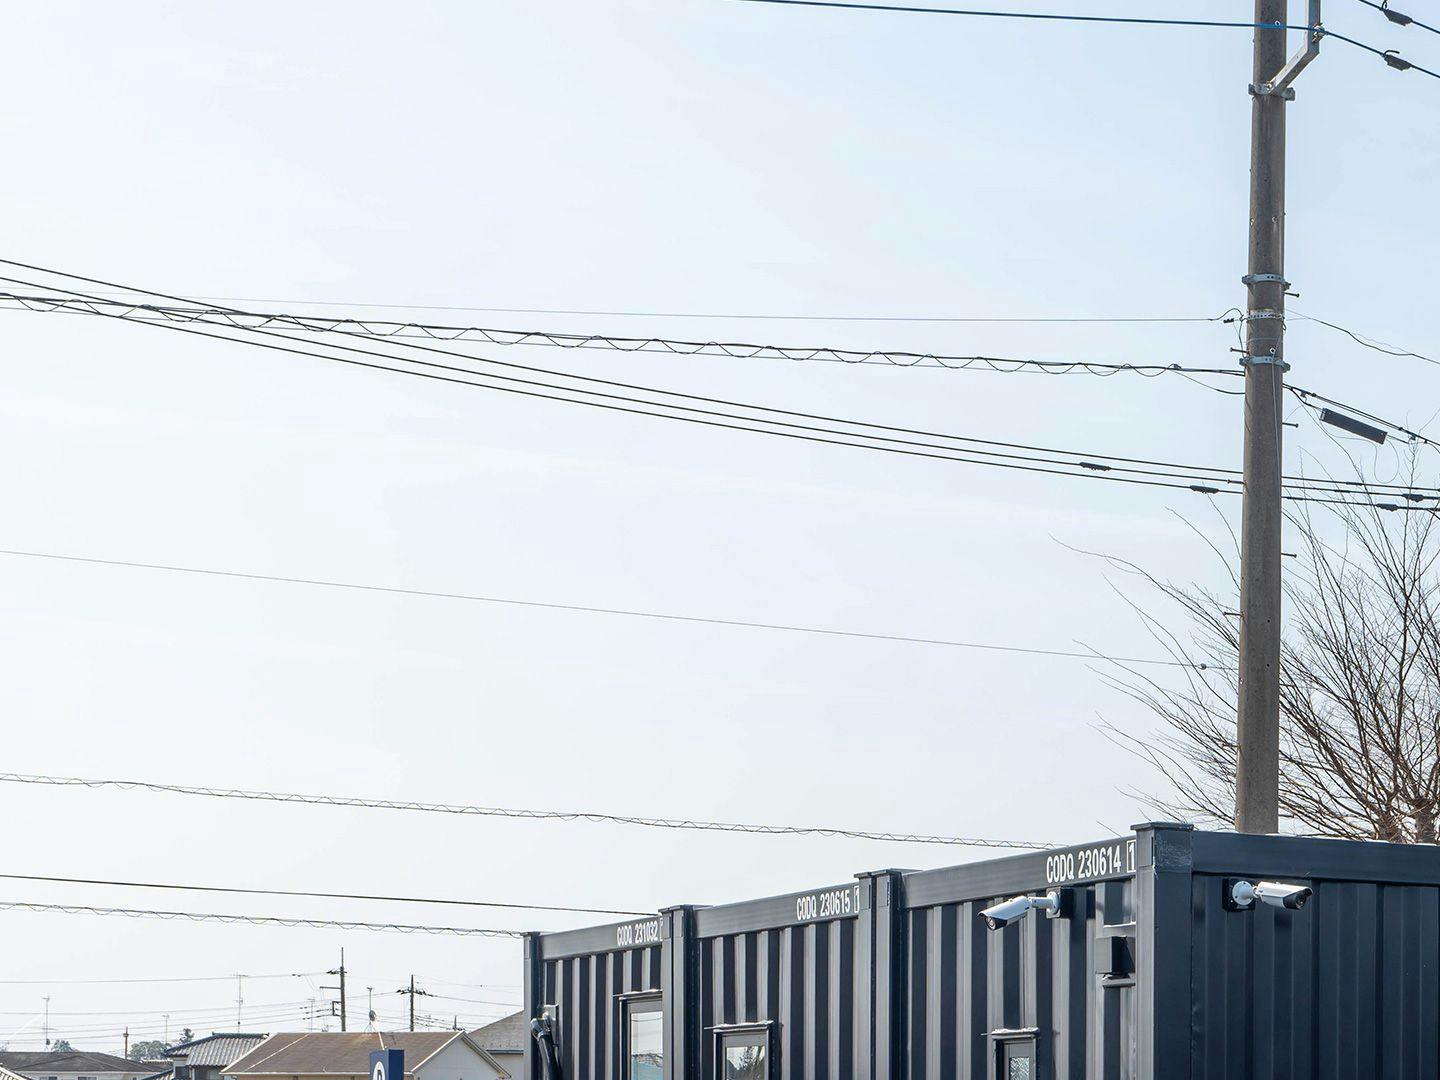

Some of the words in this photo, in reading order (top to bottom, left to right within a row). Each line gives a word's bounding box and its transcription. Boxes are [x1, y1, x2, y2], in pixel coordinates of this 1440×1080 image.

[1046, 853, 1074, 884] CODQ
[1078, 845, 1122, 879] 230614
[796, 895, 817, 921] CODQ
[820, 889, 851, 917] 230615
